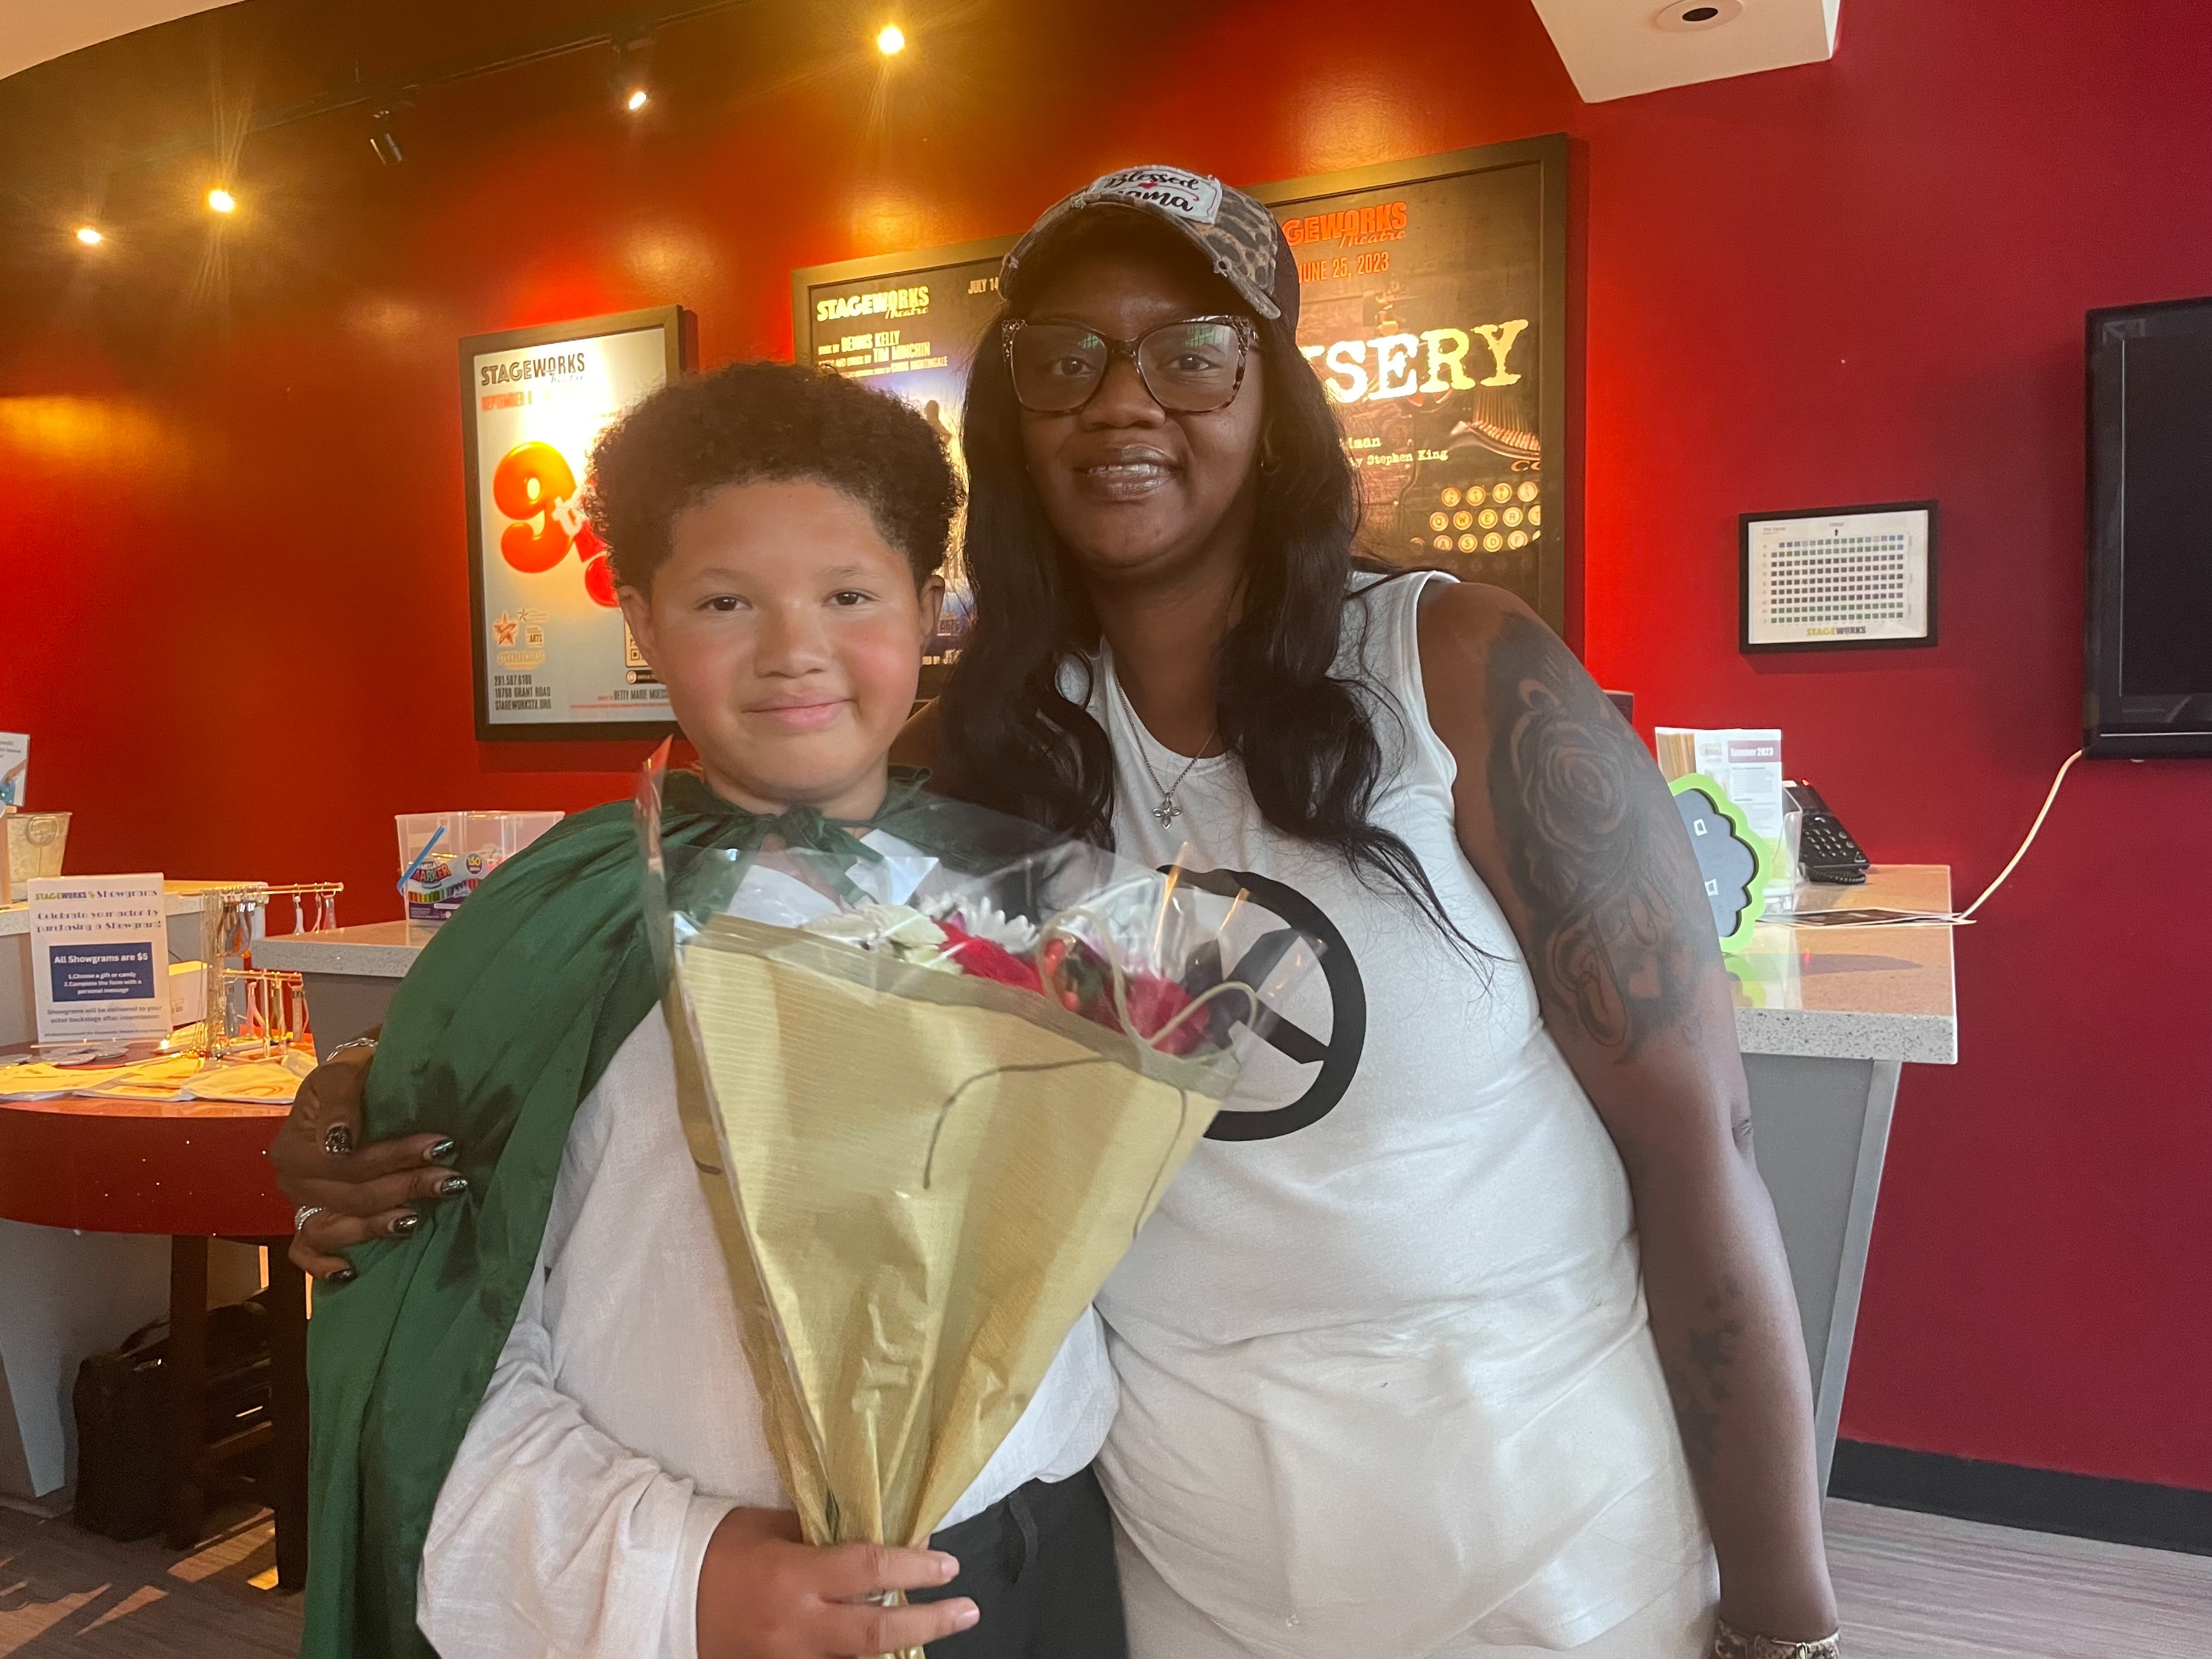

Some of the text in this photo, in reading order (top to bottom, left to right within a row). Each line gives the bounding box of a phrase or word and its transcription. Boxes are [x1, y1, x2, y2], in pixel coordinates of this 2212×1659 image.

[1103, 170, 1199, 190] Blessed
[1118, 190, 1194, 212] ama
[1282, 201, 1407, 246] GEWORKS
[1339, 227, 1407, 249] Theatre
[1299, 251, 1389, 283] JUNE 25, 2023
[968, 279, 987, 294] JULY
[816, 286, 929, 321] STAGEWORKS
[874, 330, 900, 347] KELLY
[481, 353, 585, 386] STAGEWORKS
[1300, 319, 1529, 404] SERY
[1367, 453, 1414, 466] Stephen
[1418, 449, 1449, 461] King
[1807, 626, 1866, 636] STAGEWORKS
[514, 687, 533, 697] GRANT
[535, 686, 551, 697] ROAD
[36, 891, 87, 900] STAGEWORKS
[68, 954, 119, 964] Showgrams
[137, 952, 148, 961] $5
